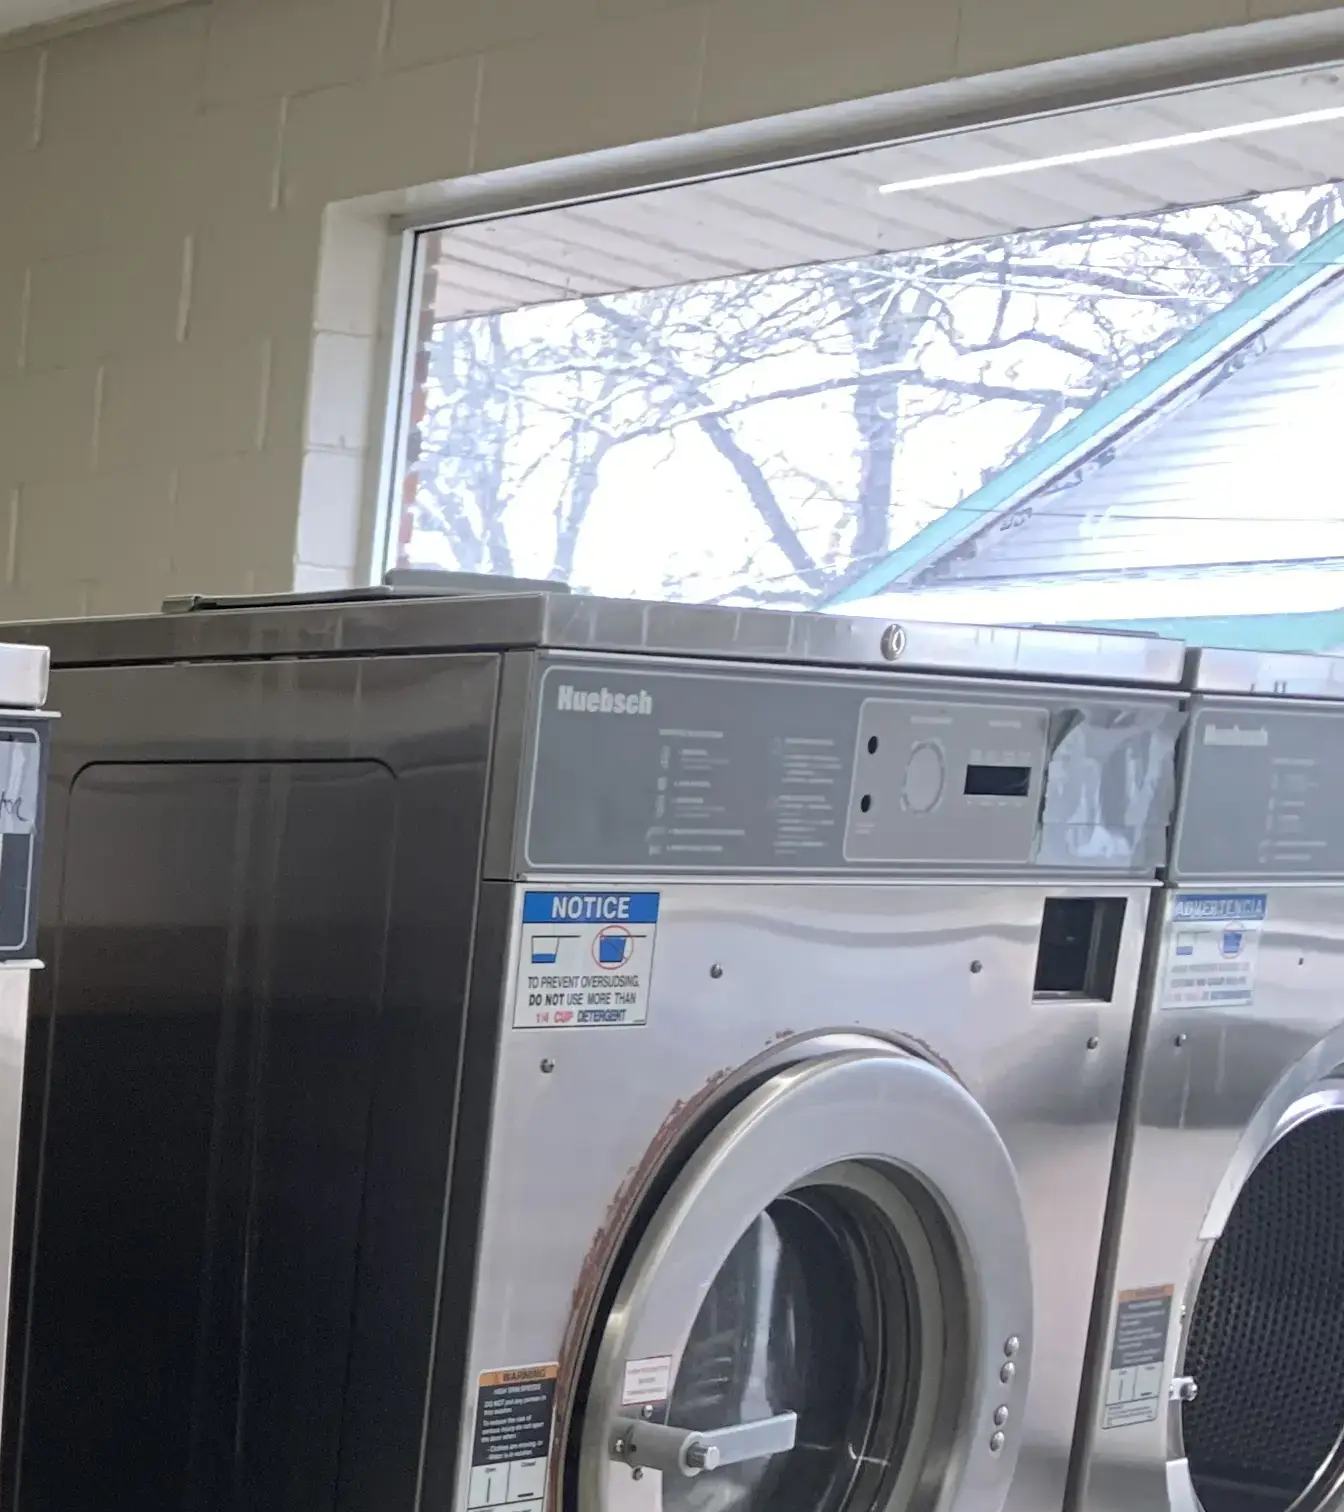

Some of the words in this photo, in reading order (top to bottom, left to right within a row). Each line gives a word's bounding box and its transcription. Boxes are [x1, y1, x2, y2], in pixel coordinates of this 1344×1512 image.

[558, 685, 652, 715] Huebsch
[551, 896, 631, 919] NOTICE
[528, 976, 539, 989] TO
[541, 976, 580, 989] PREVENT
[529, 994, 542, 1006] DO
[545, 993, 565, 1006] NOT
[566, 993, 583, 1005] USE
[587, 993, 610, 1005] MORE
[614, 992, 636, 1004] THAN
[554, 1011, 574, 1023] CUP
[577, 1009, 627, 1022] DETERGENT
